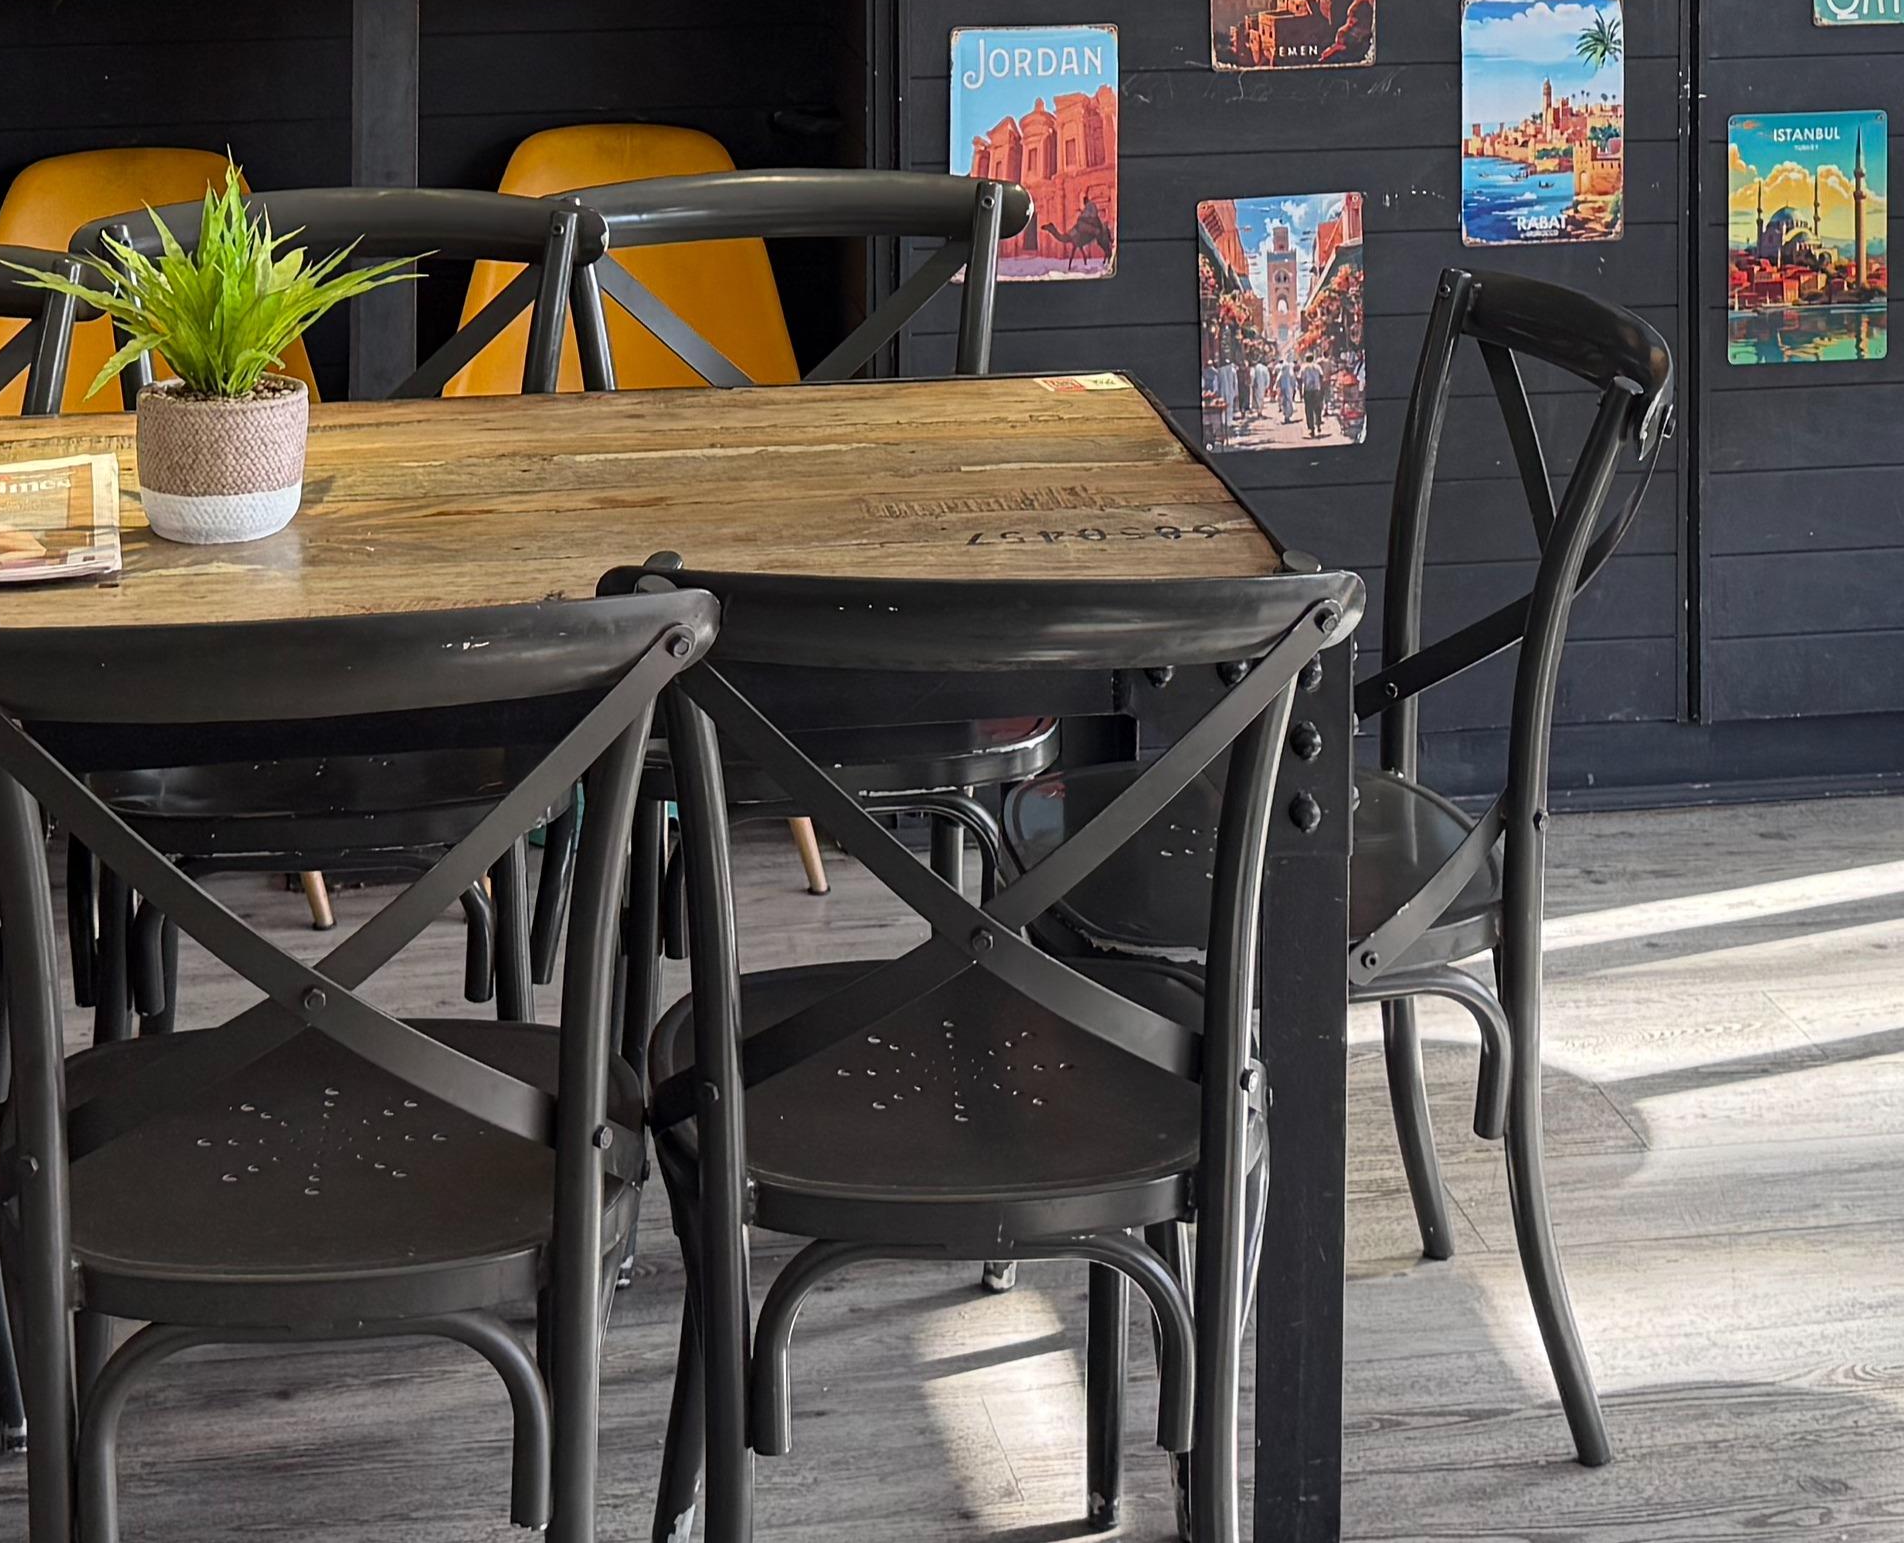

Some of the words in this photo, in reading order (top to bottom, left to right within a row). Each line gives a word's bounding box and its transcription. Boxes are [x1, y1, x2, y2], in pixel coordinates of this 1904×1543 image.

[963, 39, 1103, 90] JORDAN
[1773, 126, 1840, 142] ISTANBUL
[1517, 214, 1568, 231] RABAT
